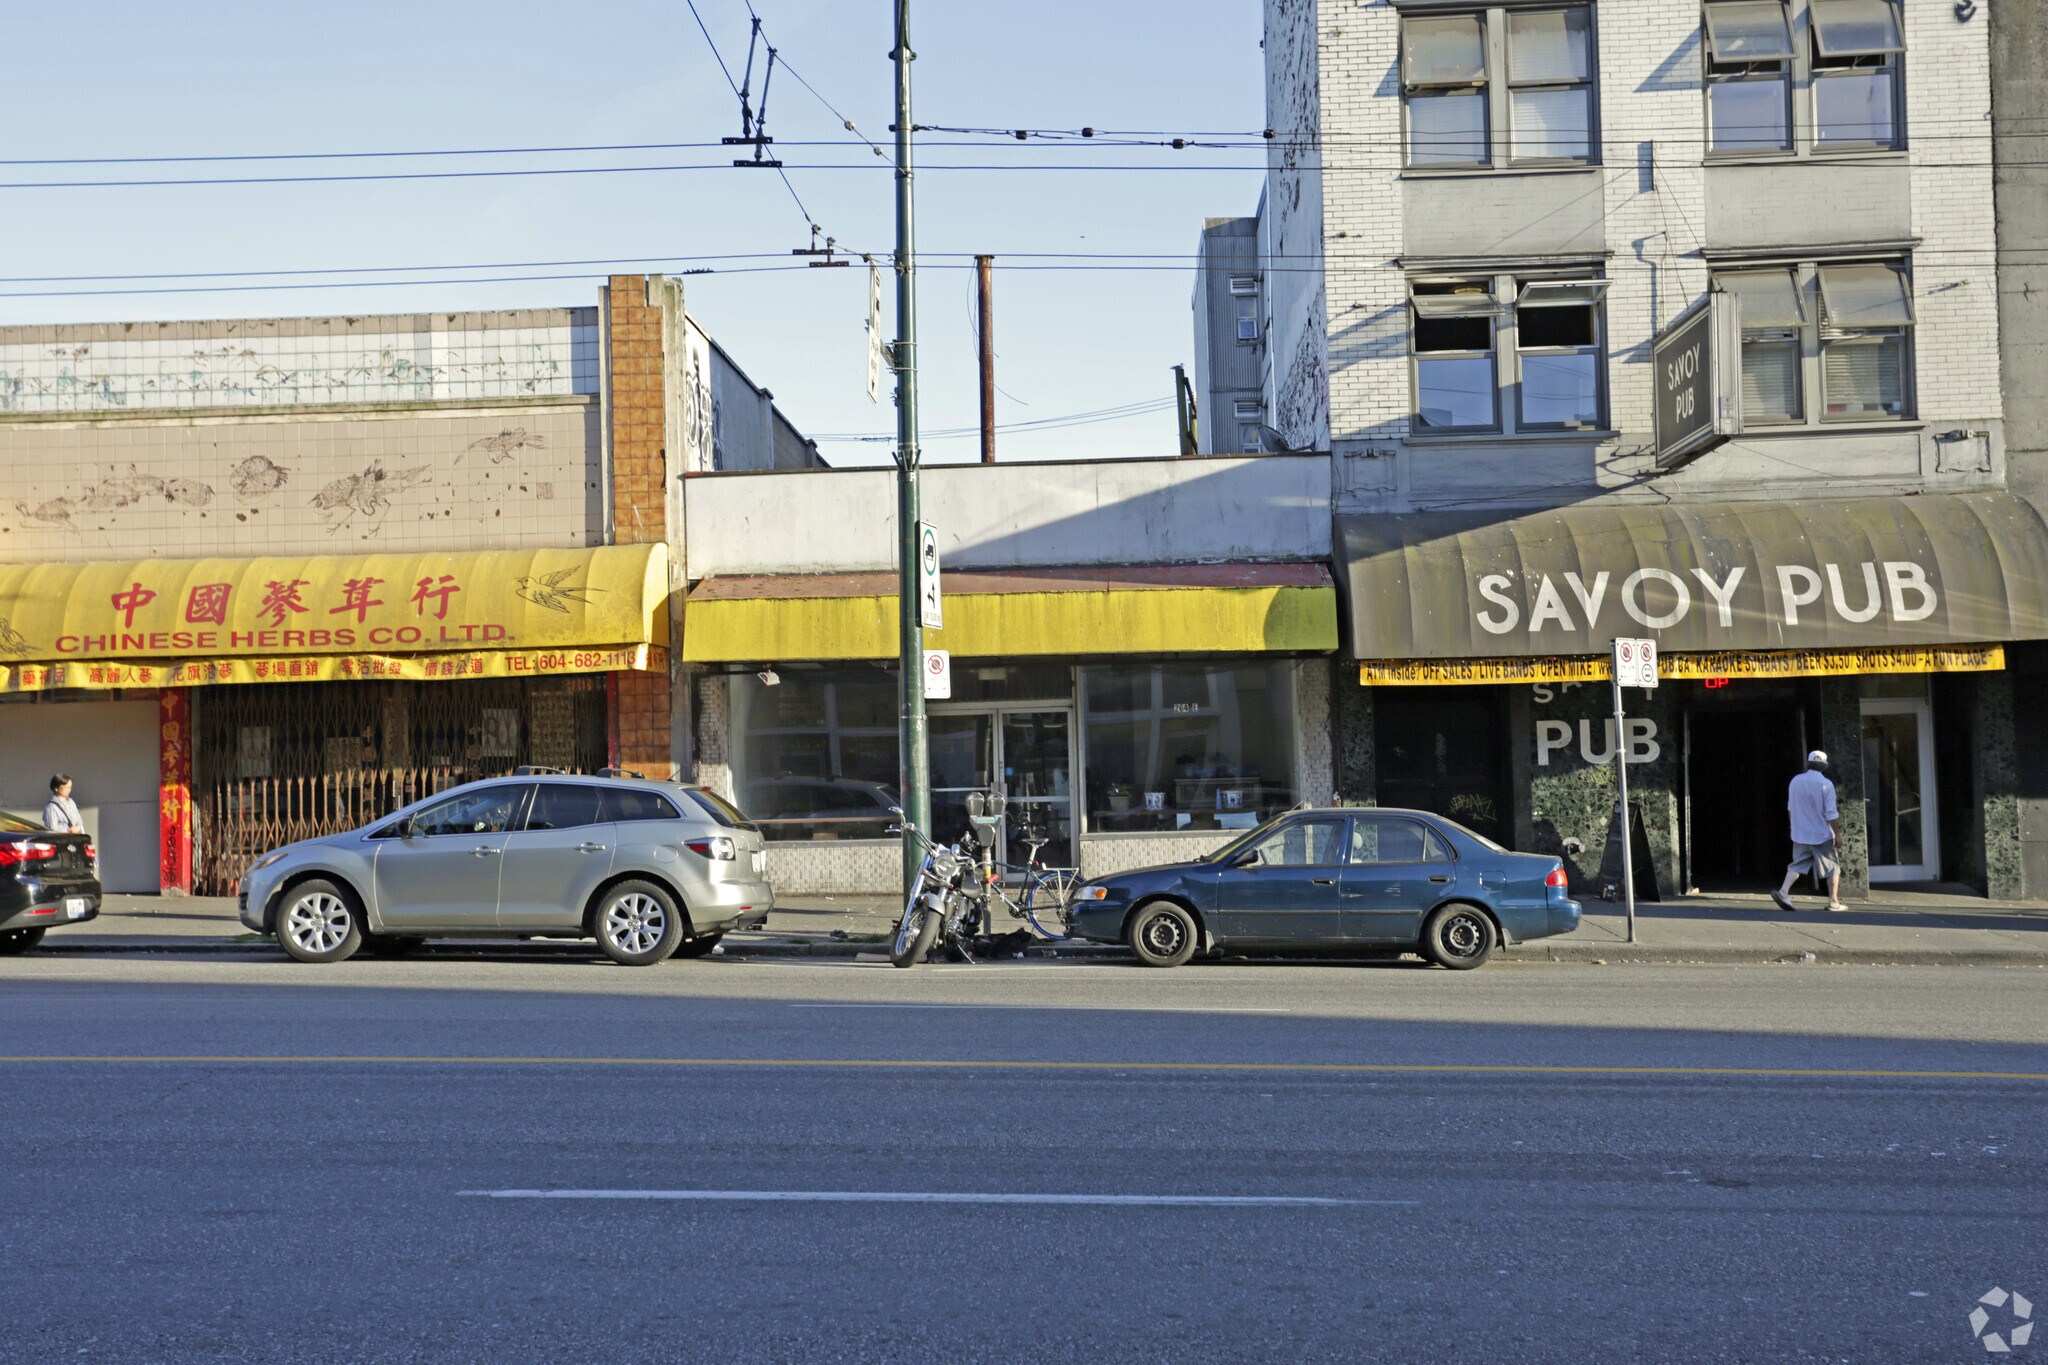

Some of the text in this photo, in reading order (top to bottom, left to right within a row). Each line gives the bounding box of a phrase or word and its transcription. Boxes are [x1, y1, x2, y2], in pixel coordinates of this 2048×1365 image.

[1668, 342, 1700, 391] SAVOY
[1676, 386, 1695, 423] PUB
[1476, 561, 1938, 634] SAVOY PUB
[55, 631, 218, 654] CHINESE
[231, 628, 356, 649] HERBS
[439, 624, 516, 643] LTD.
[505, 655, 535, 671] TEL:
[1366, 662, 1387, 680] ATM
[1422, 661, 1440, 680] OFF
[1442, 660, 1473, 680] SALES
[1480, 659, 1500, 679] LIVE
[1503, 659, 1535, 679] BANDS
[1540, 658, 1565, 678] OPEN
[1569, 657, 1592, 677] MIKE
[1696, 654, 1742, 673] KARAOKE
[1744, 653, 1789, 672] SUNDAYS
[1796, 650, 1821, 670] BEER
[1856, 649, 1888, 669] SHOTS
[1933, 648, 1953, 667] FUN
[1955, 647, 1987, 666] PLACE
[1536, 718, 1660, 766] PUB
